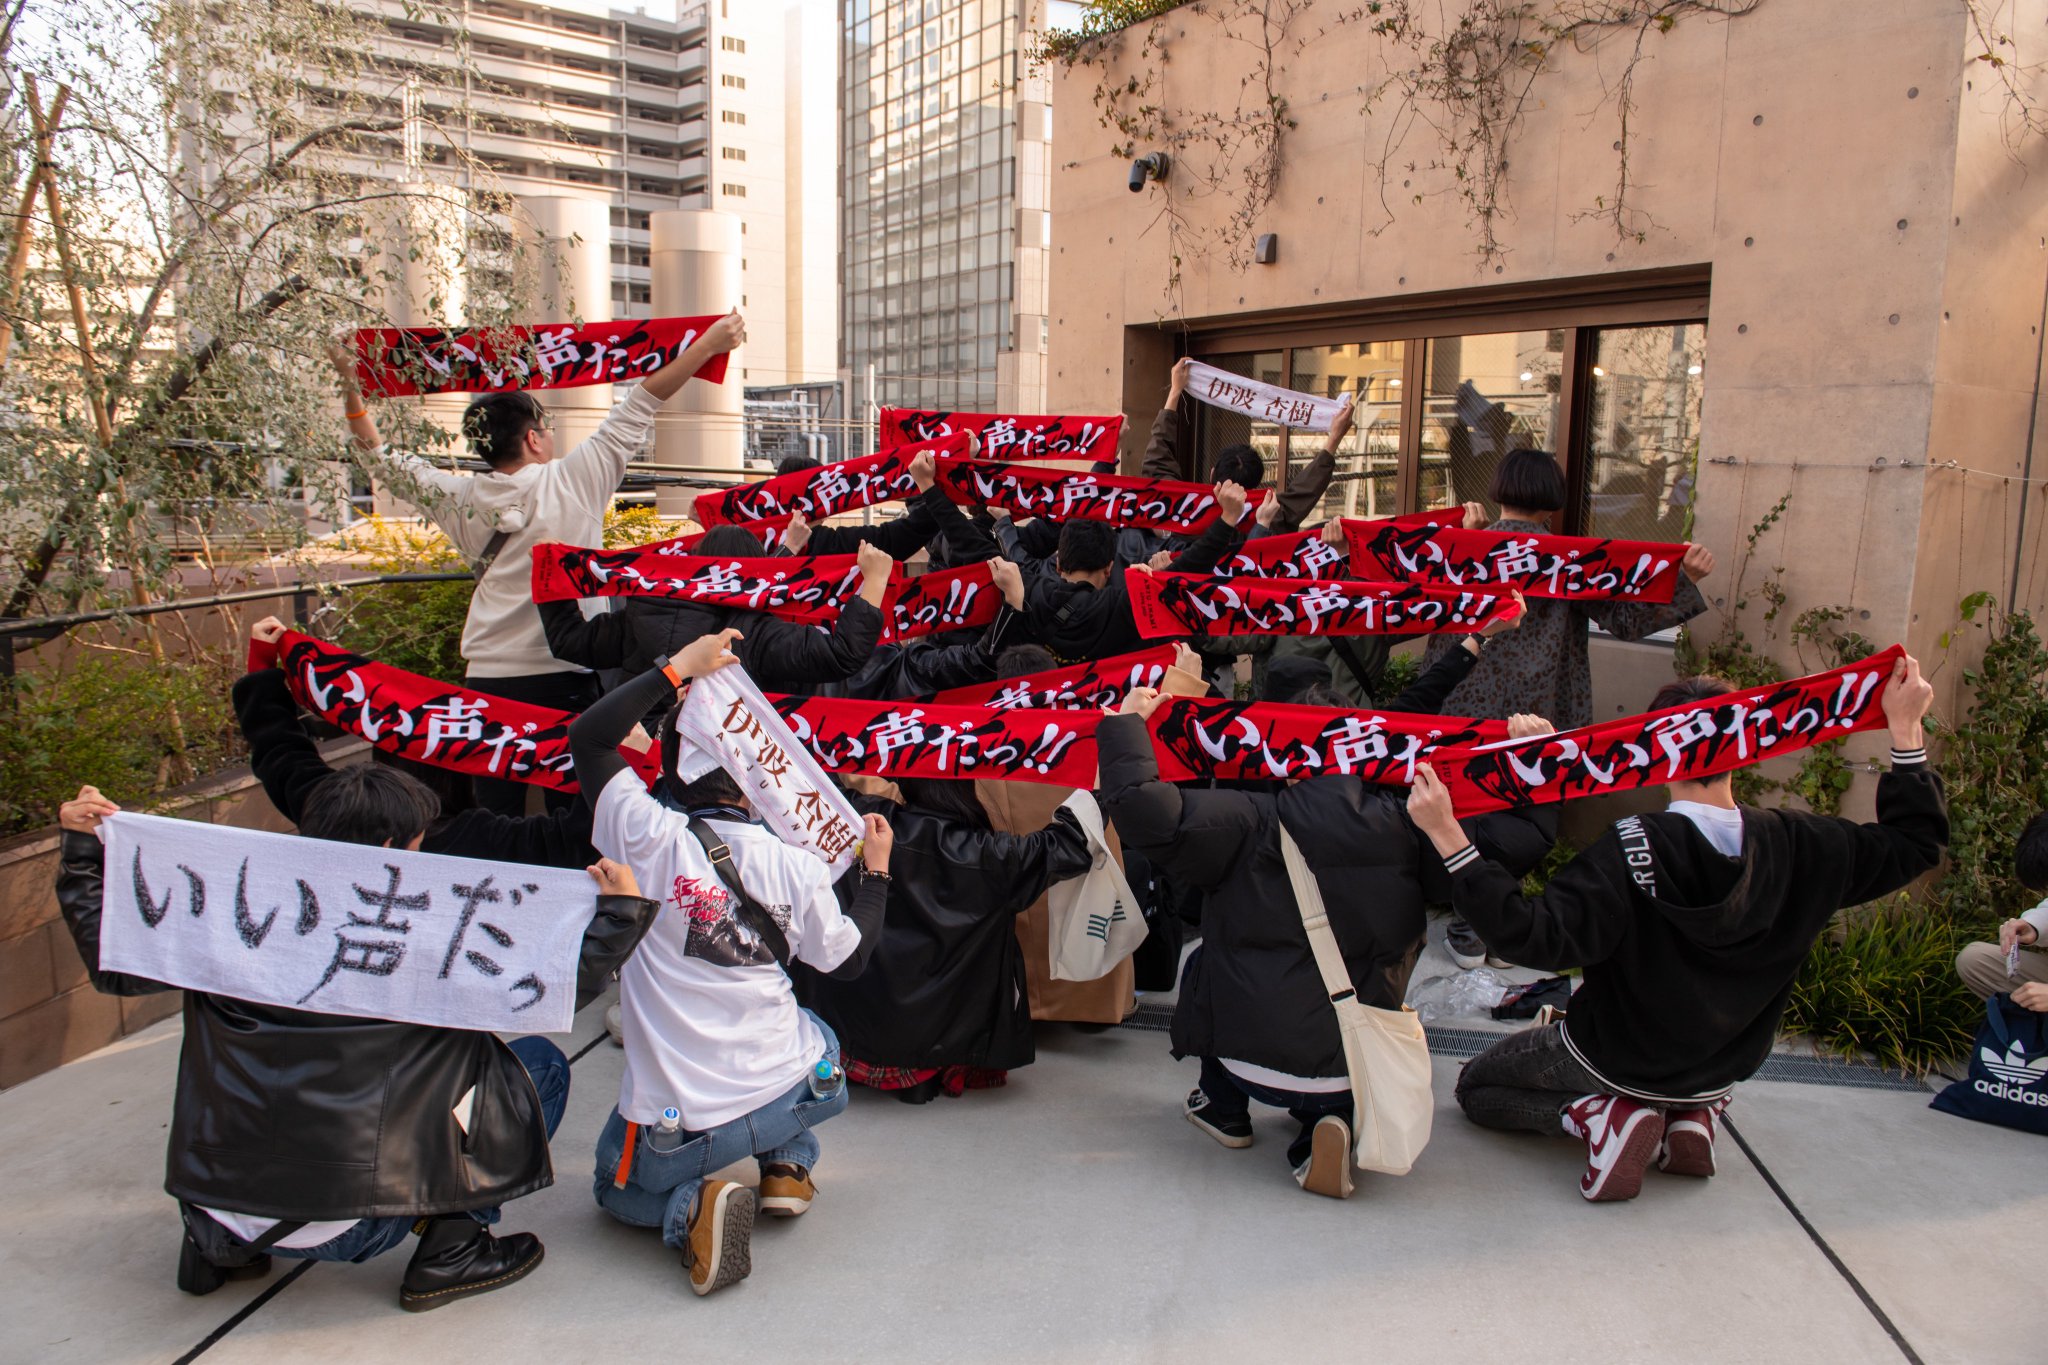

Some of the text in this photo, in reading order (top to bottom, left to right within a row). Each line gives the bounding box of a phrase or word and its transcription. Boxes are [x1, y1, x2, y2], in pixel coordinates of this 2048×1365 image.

[1208, 377, 1257, 410] 伊波
[1264, 396, 1316, 426] 杏樹
[918, 417, 1106, 459] い声だっ!!
[738, 450, 951, 516] いい声だっ
[589, 559, 863, 611] いい声だっ!
[1394, 538, 1669, 595] いい声だっ!!
[1188, 583, 1496, 634] いい声だっ!!
[1510, 672, 1880, 787] いい声だっ!!
[715, 731, 816, 855] ANJU INA
[722, 697, 859, 864] 伊波 杏樹
[132, 845, 546, 1012] いい声だっ
[1974, 1079, 2048, 1107] adidas
